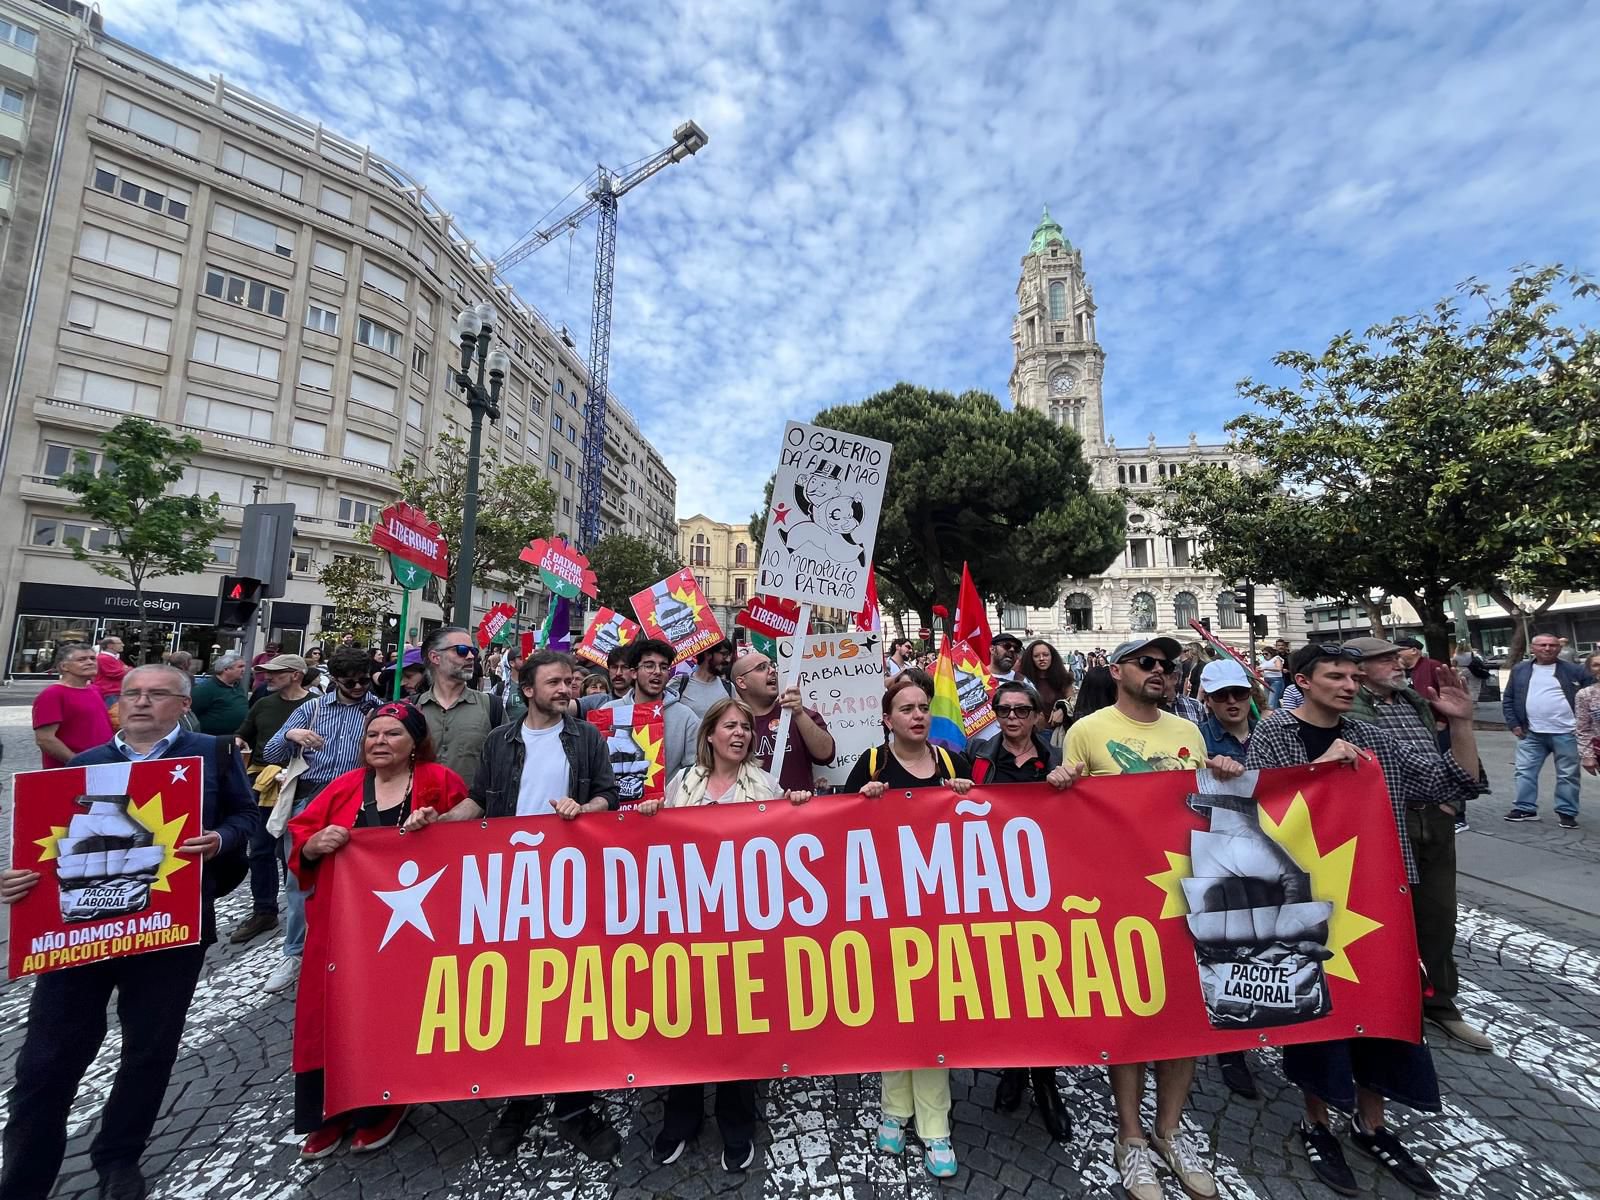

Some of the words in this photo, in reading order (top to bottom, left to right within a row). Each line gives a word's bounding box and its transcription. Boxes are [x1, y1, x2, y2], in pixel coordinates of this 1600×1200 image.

[788, 427, 804, 447] O
[781, 448, 809, 469] DÁ
[805, 454, 818, 469] A
[844, 464, 880, 485] MÃO
[389, 517, 439, 560] LIBERDADE
[541, 556, 553, 571] OS
[552, 563, 583, 588] PREÇOS
[546, 547, 553, 560] É
[552, 552, 582, 577] BAIXAR
[761, 569, 783, 588] DO
[795, 573, 856, 599] PATRÃO
[751, 605, 797, 635] LIBERDAD
[802, 639, 859, 659] LUIS
[783, 663, 883, 686] RABALHOU
[811, 695, 878, 716] ALÁRIO
[829, 689, 840, 698] O
[459, 830, 587, 945] NÃO
[602, 833, 829, 936] DAMOS
[845, 829, 888, 922] A
[898, 800, 1052, 917] MÃO
[77, 897, 126, 907] LABORAL
[83, 889, 126, 898] PACOTE
[31, 931, 66, 954] NÃO
[69, 923, 124, 947] DAMOS
[126, 922, 138, 935] A
[139, 911, 171, 931] MÃO
[22, 954, 46, 973] AO
[49, 940, 109, 967] PACOTE
[111, 935, 132, 954] DO
[135, 924, 189, 950] PATRÃO
[416, 950, 508, 1055] AO
[525, 939, 770, 1046] PACOTE
[783, 930, 875, 1032] DO
[889, 895, 1167, 1024] PATRÃO
[1230, 964, 1289, 984] PACOTE
[1224, 980, 1293, 1003] LABORAL
